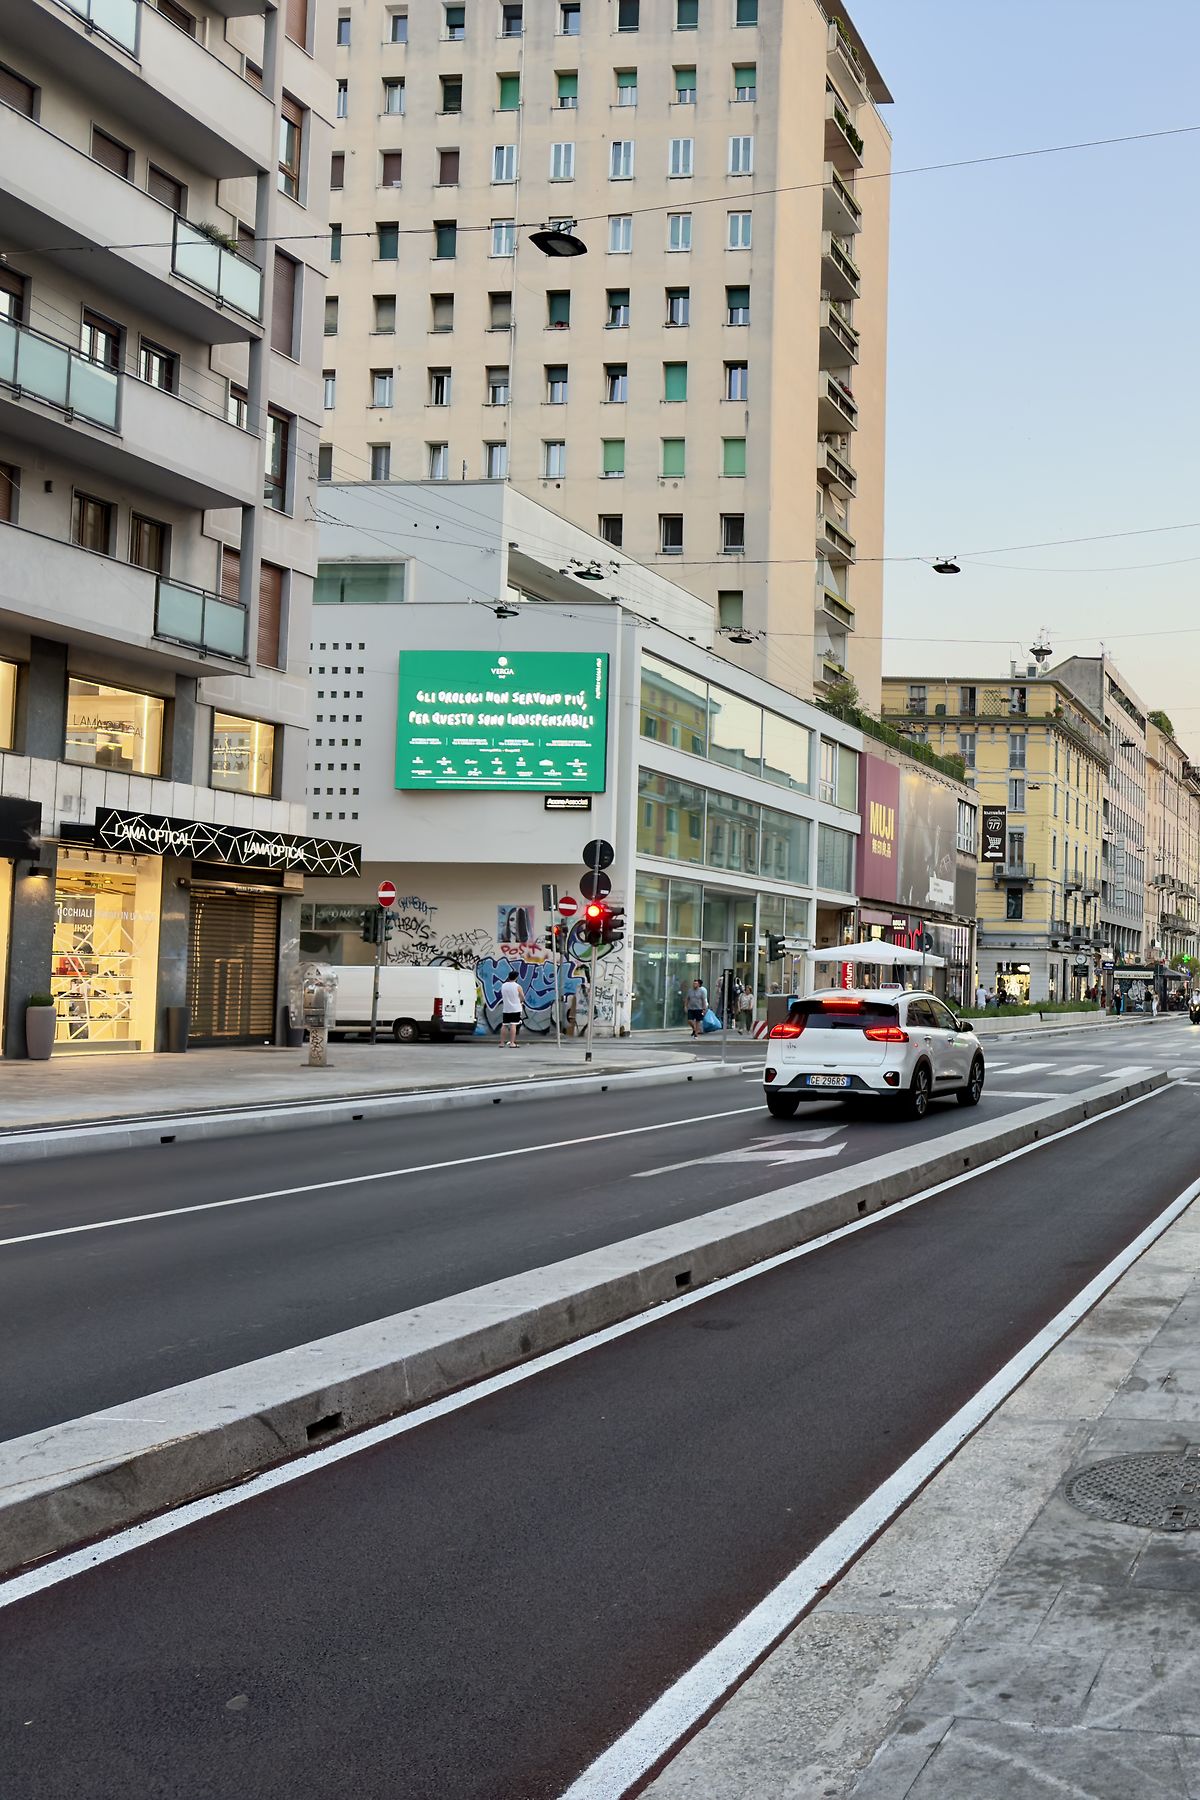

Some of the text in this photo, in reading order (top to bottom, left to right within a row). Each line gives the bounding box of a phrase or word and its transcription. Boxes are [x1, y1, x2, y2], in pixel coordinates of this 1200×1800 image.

[416, 691, 435, 703] GLI
[438, 691, 483, 704] OROLOGI
[486, 691, 509, 704] NON
[512, 691, 561, 705] SERVONO
[409, 711, 594, 729] PER QUESTO SONO INDISPENSABILI
[870, 800, 895, 841] MUJI
[988, 821, 1001, 830] 7/7
[114, 823, 193, 846] LAMA OPTICAL
[244, 840, 306, 860] LAMA OPTICAL
[57, 907, 92, 918] OCCHIALI
